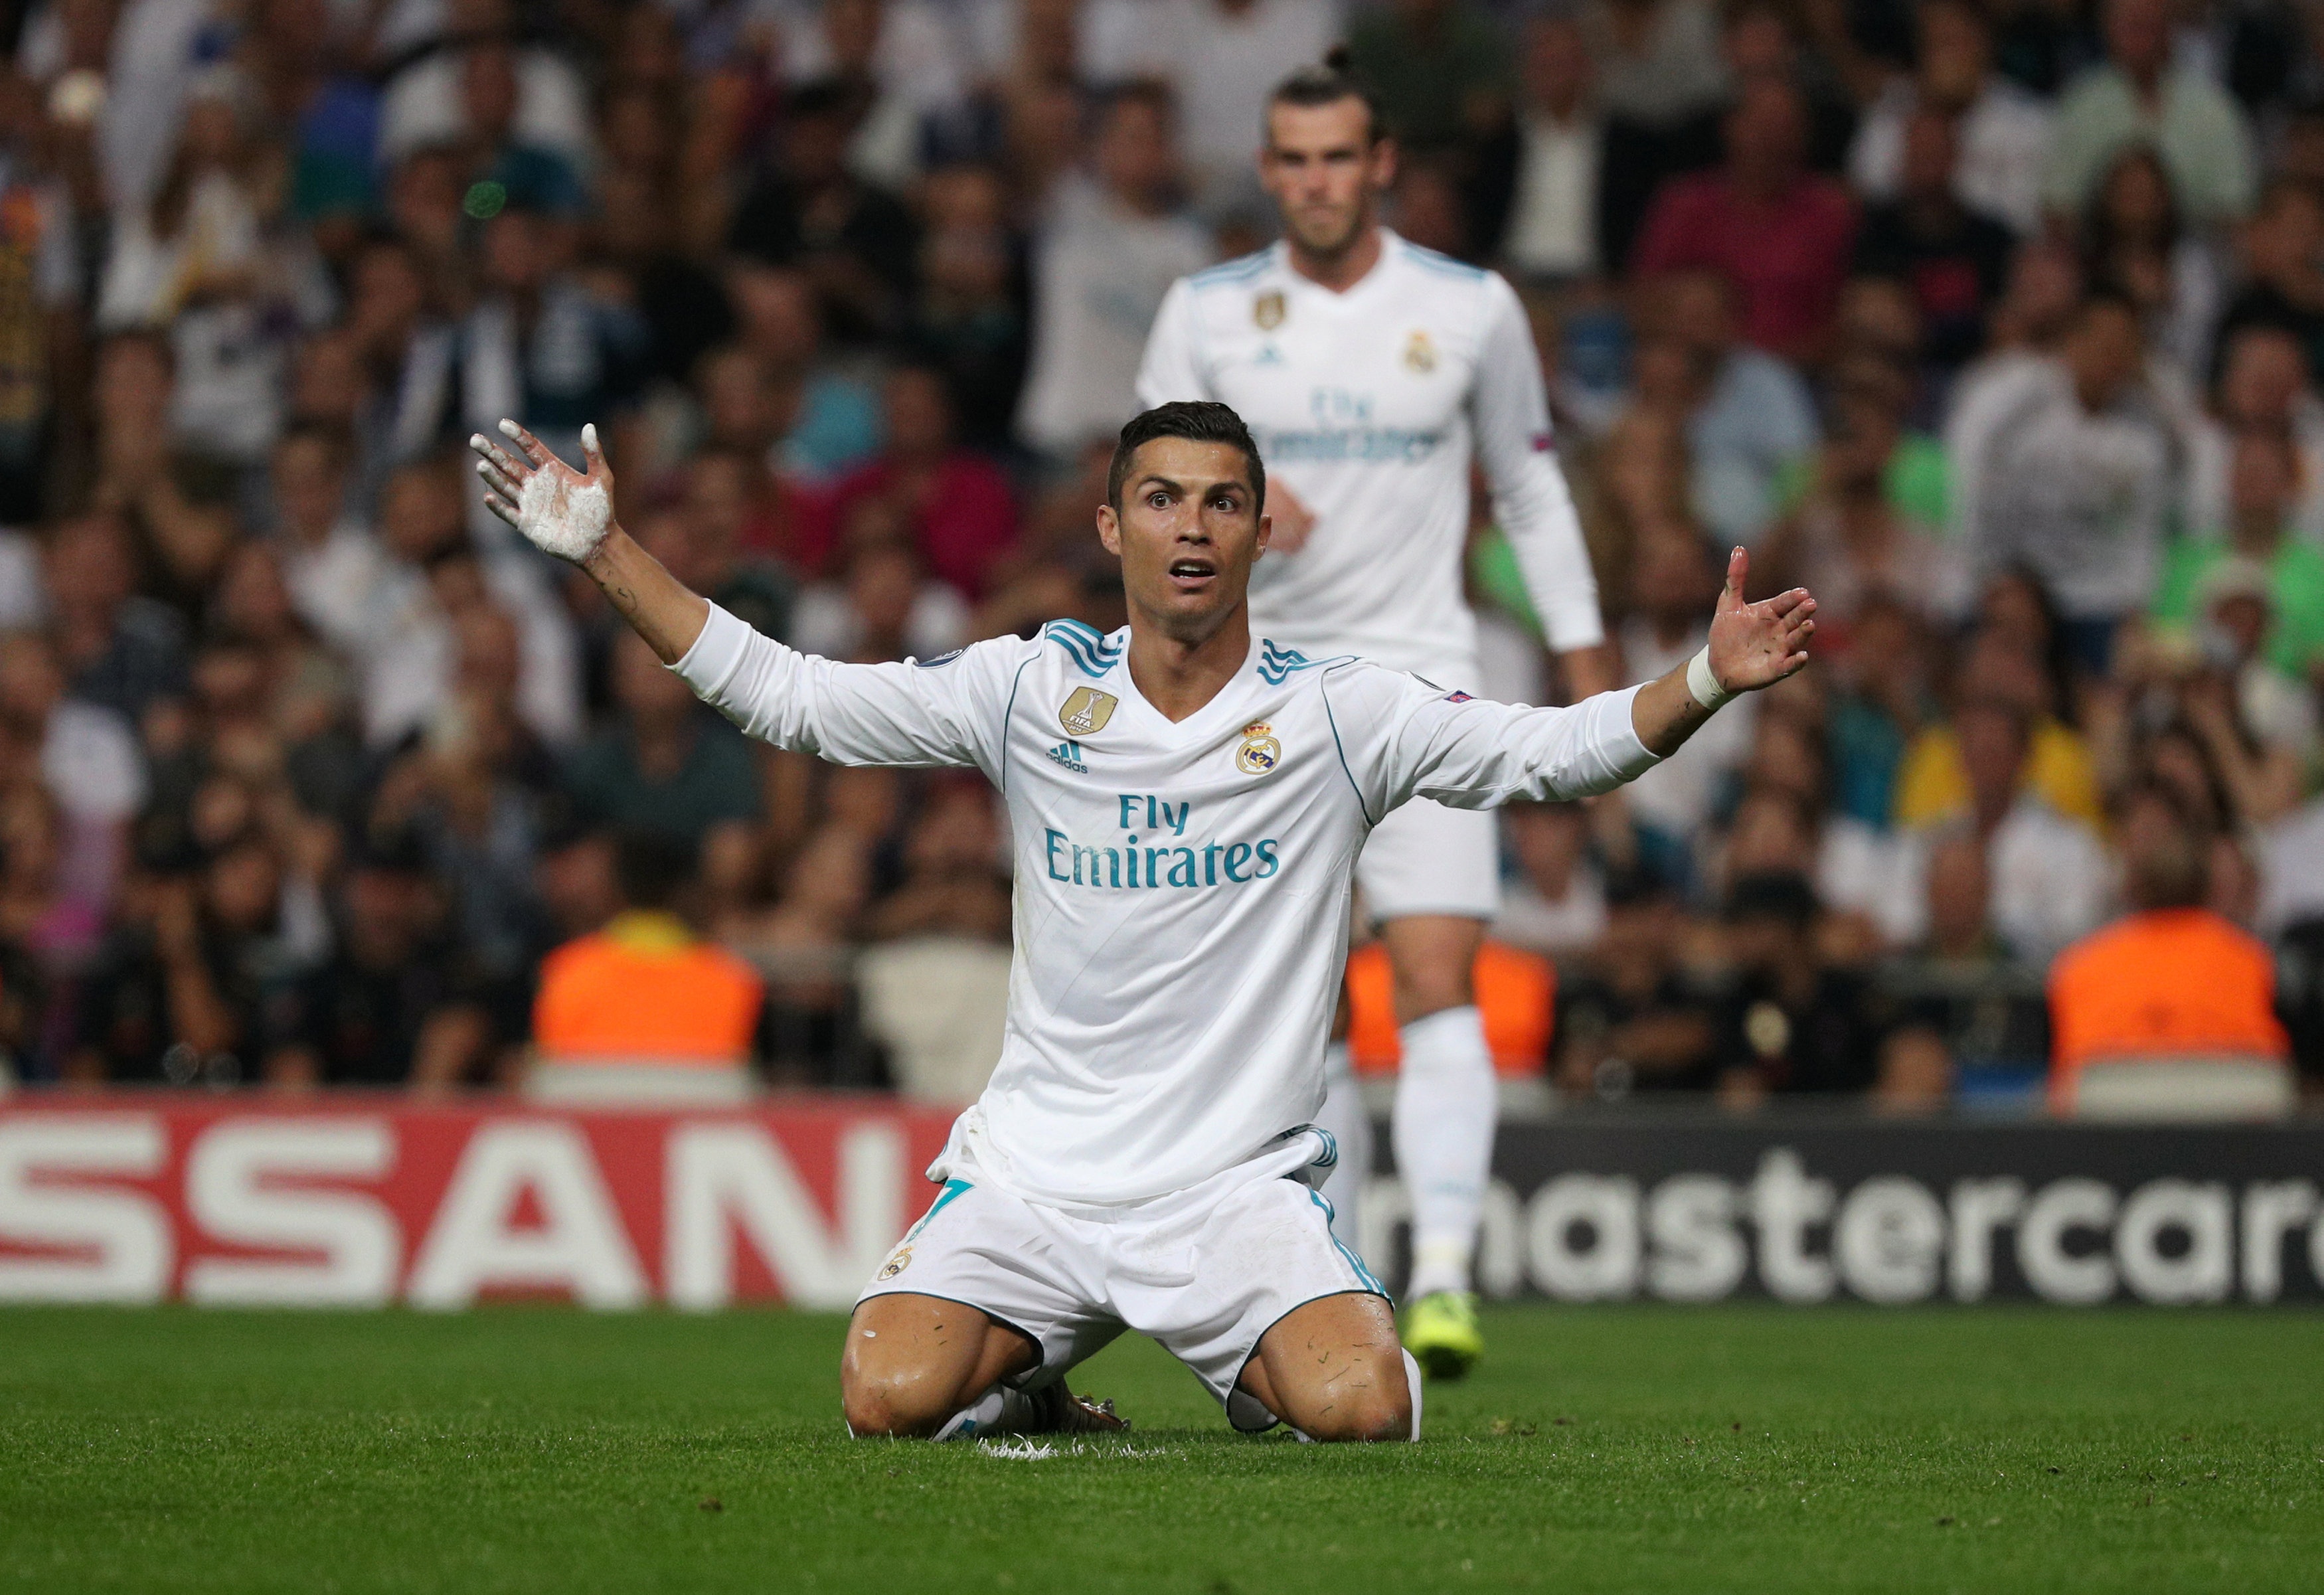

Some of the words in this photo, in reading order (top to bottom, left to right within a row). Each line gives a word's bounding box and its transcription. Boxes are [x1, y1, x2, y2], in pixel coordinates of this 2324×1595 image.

[1069, 714, 1091, 728] FIFA
[1046, 752, 1088, 774] adidas
[1118, 794, 1190, 836] Fly
[1044, 827, 1280, 888] Emirates
[905, 1178, 975, 1244] 7
[1358, 1145, 2324, 1305] mastercar
